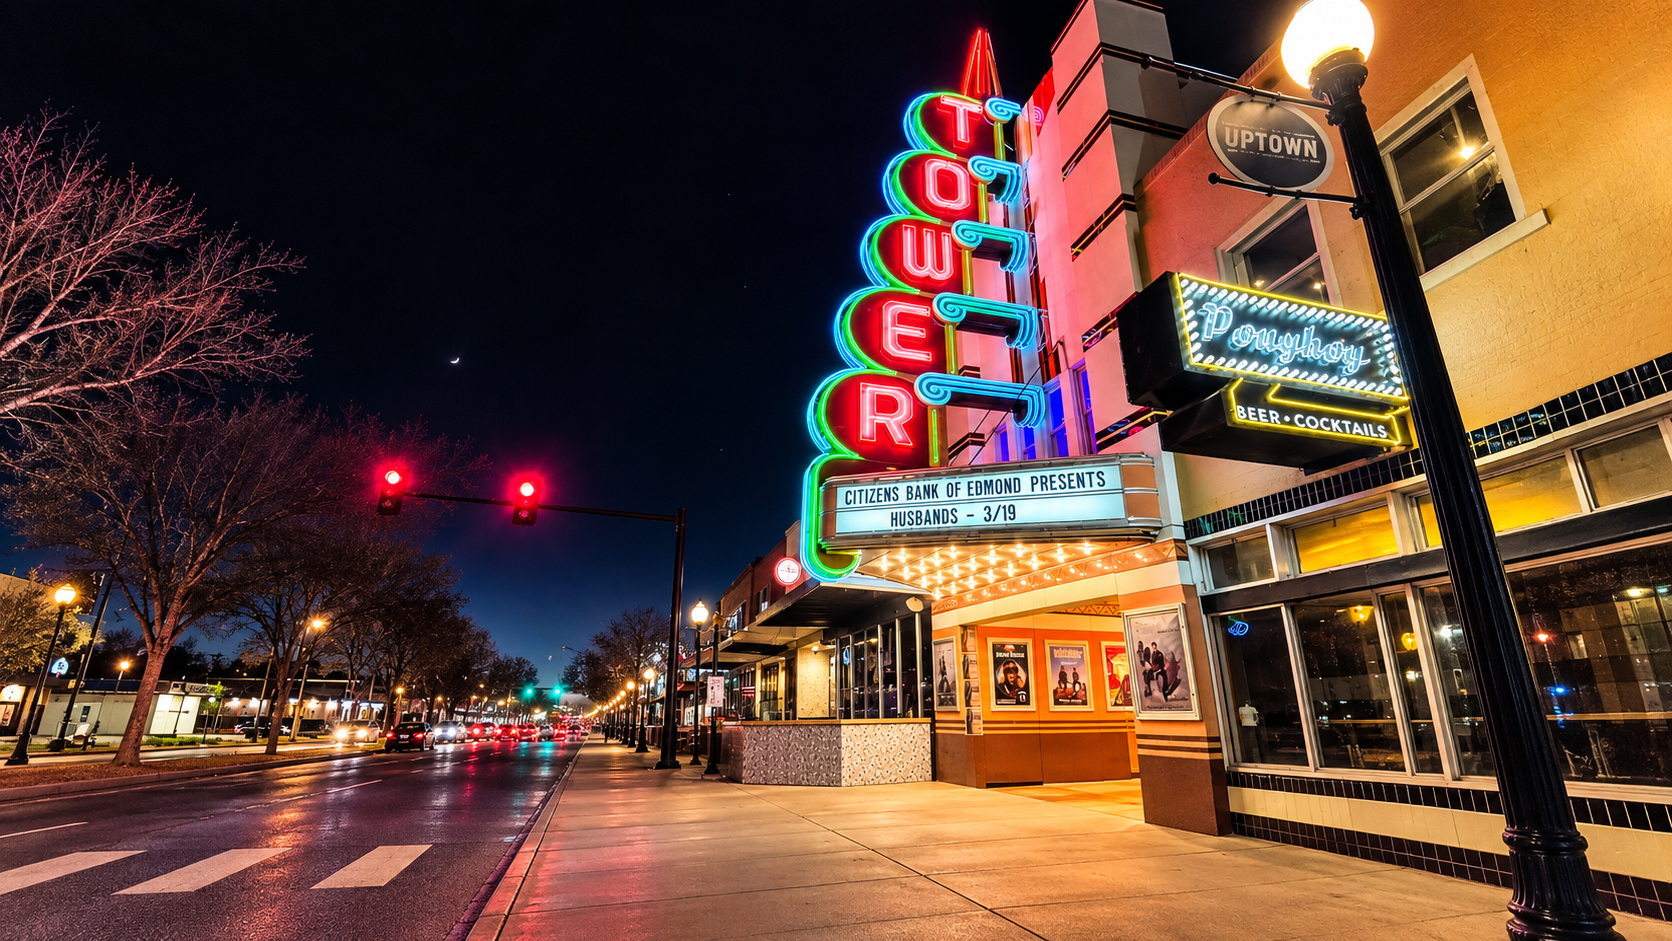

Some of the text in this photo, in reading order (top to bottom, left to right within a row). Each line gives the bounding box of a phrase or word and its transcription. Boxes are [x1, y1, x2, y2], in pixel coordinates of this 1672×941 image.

[1225, 127, 1317, 158] UPTOWN
[859, 95, 983, 446] TOWER
[1237, 405, 1387, 438] BEER COCKTAILS
[845, 471, 1106, 505] CITIZENS BANK OF EDMOND PRESENTS
[891, 508, 958, 527] HUSBANDS
[983, 503, 1017, 523] 3/19
